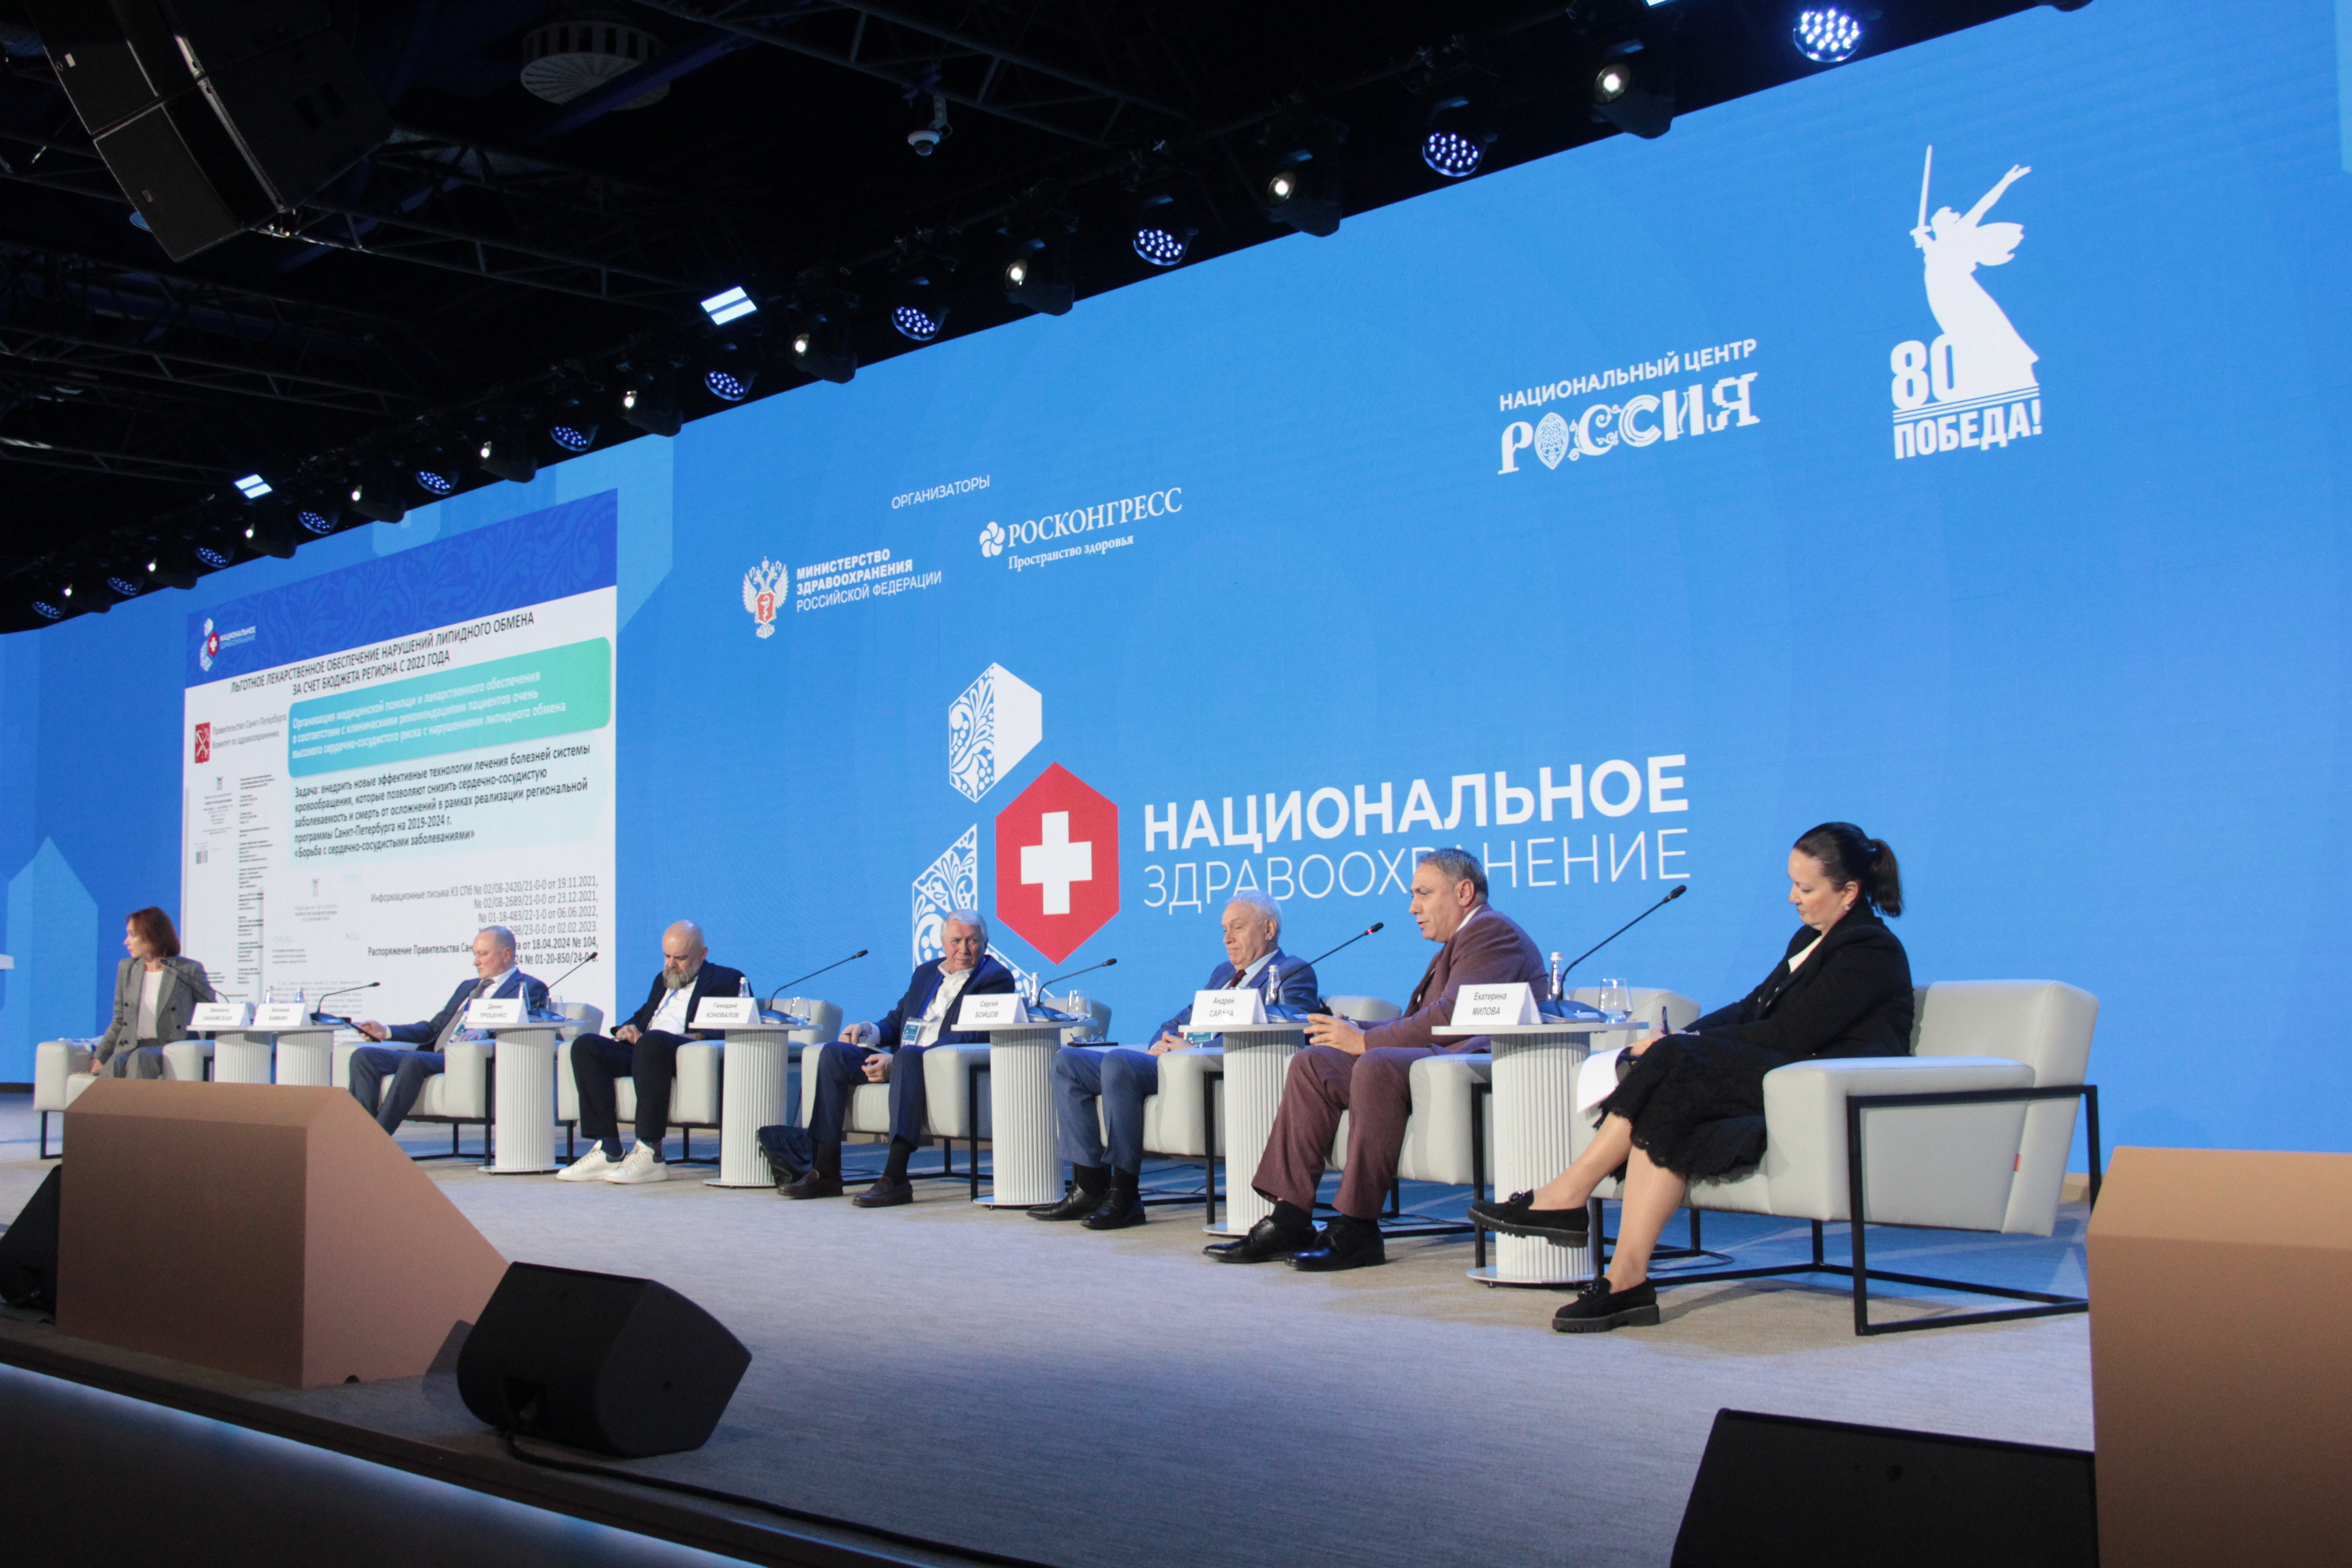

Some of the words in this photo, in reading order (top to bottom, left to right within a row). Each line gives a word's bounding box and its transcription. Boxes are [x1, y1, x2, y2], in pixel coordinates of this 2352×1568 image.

[1499, 351, 1680, 412] НАЦИОНАЛЬНЫЙ
[1684, 338, 1757, 372] ЦЕНТР
[1890, 333, 1968, 409] 80
[1893, 399, 2043, 459] ПОБЕДА!
[891, 475, 990, 509] ОРГАНИЗАТОРЫ
[1008, 487, 1182, 547] РОСКОНГРЕСС
[797, 549, 890, 580] МИНИСТЕРСТВО
[1008, 546, 1082, 572] Пространство
[1083, 534, 1134, 555] здоровья
[796, 559, 913, 596] ЗДРАВООХРАНЕНИЯ
[796, 583, 869, 612] РОССИЙСКОЙ
[872, 570, 942, 596] ФЕДЕРАЦИИ
[231, 675, 265, 693] ЛЬГОТНОЕ
[266, 661, 324, 684] ЛЕКАРСТВЕННОЕ
[327, 648, 379, 671] ОБЕСПЕЧЕНИЕ
[382, 632, 433, 658] НАРУШЕНИЙ
[435, 622, 491, 646] ЛИПИДНОГО
[493, 612, 534, 632] ОБМЕНА
[293, 683, 302, 696] ЗА
[303, 678, 321, 693] СЧЕТ
[322, 670, 360, 689] БЮДЖЕТА
[362, 662, 398, 680] РЕГИОНА
[400, 659, 405, 672] С
[406, 655, 425, 671] 2022
[427, 650, 450, 666] ГОДА
[295, 786, 319, 799] Задача:
[321, 781, 353, 794] внедрить
[353, 778, 376, 788] новые
[377, 770, 427, 786] эффективные
[429, 763, 472, 777] технологии
[474, 757, 508, 770] лечения
[510, 747, 550, 765] болезней
[553, 745, 590, 759] системы
[294, 813, 348, 828] заболеваемость
[349, 813, 353, 821] и
[355, 809, 380, 820] смерть
[381, 807, 389, 817] от
[390, 802, 436, 815] осложнений
[438, 800, 443, 809] в
[444, 796, 472, 810] рамках
[474, 789, 524, 806] реализации
[526, 781, 588, 800] региональной
[295, 797, 353, 813] кровообращения,
[355, 792, 385, 804] которые
[387, 786, 426, 799] позволяют
[427, 782, 457, 794] снизить
[458, 769, 547, 790] сердечно-сосудистую
[1144, 753, 1689, 854] НАЦИОНАЛЬНОЕ
[294, 831, 333, 843] программы
[334, 822, 395, 838] Санкт-Петербурга
[397, 821, 406, 831] на
[407, 814, 445, 830] 2019-2024
[446, 815, 452, 825] г.
[323, 846, 327, 855] с
[328, 838, 409, 855] сердечно-сосудистыми
[410, 830, 475, 845] заболеваниями»
[371, 891, 425, 903] Информационные
[426, 889, 449, 898] письма
[451, 886, 458, 897] КЗ
[460, 884, 473, 896] СПб
[474, 885, 482, 895] №
[483, 879, 547, 894] 02/08-2420/21-0-0
[548, 880, 556, 889] от
[558, 875, 598, 889] 19.11.2021,
[1144, 828, 1690, 915] ЗДРАВООХНЕНИЕ
[474, 898, 482, 909] №
[483, 893, 547, 908] 02/08-2689/21-0-0
[548, 895, 556, 904] от
[557, 890, 598, 903] 23.12.2021,
[478, 912, 487, 923] №
[488, 908, 547, 922] 01-18-483/22-1-0
[548, 910, 556, 919] от
[557, 905, 598, 918] 06.06.2022,
[523, 941, 530, 950] от
[532, 937, 570, 950] 18.04.2024
[572, 937, 581, 948] №
[583, 936, 598, 949] 104,
[548, 925, 556, 934] от
[557, 920, 598, 933] 02.02.2023.
[368, 946, 412, 957] Распоряжение
[413, 944, 460, 956] Правительства
[525, 954, 533, 964] №
[1213, 997, 1235, 1005] Андрей
[1472, 1006, 1500, 1015] МИЛОВА
[1473, 992, 1507, 1001] Екатерина
